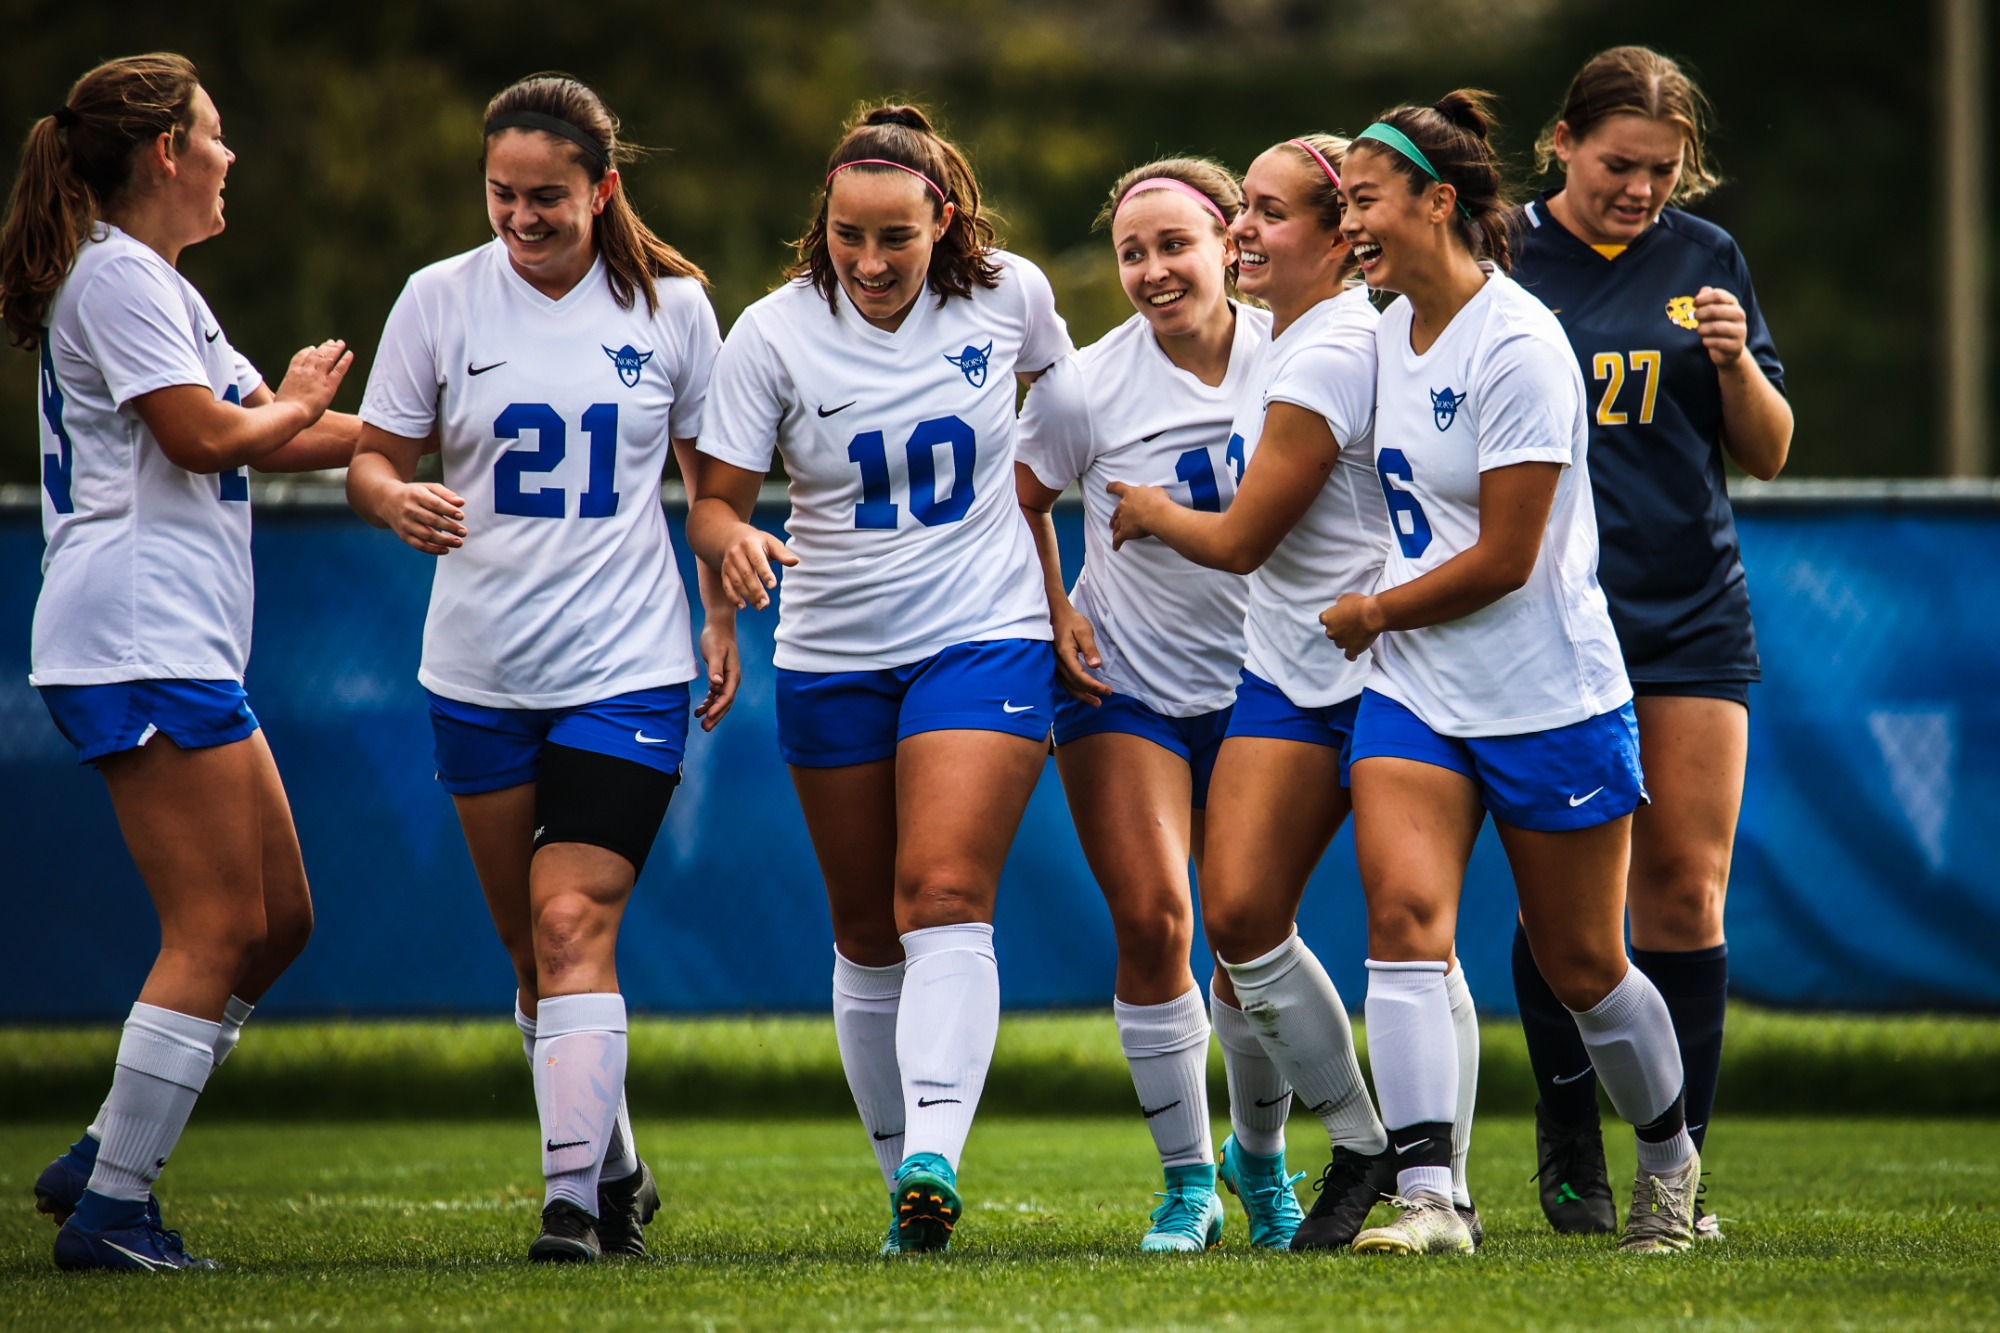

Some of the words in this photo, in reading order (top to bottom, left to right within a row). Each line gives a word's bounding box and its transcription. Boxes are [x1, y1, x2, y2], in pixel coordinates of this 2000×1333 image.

[1593, 349, 1662, 426] 27
[493, 403, 619, 518] 21
[847, 415, 976, 529] 10
[1376, 447, 1433, 558] 6
